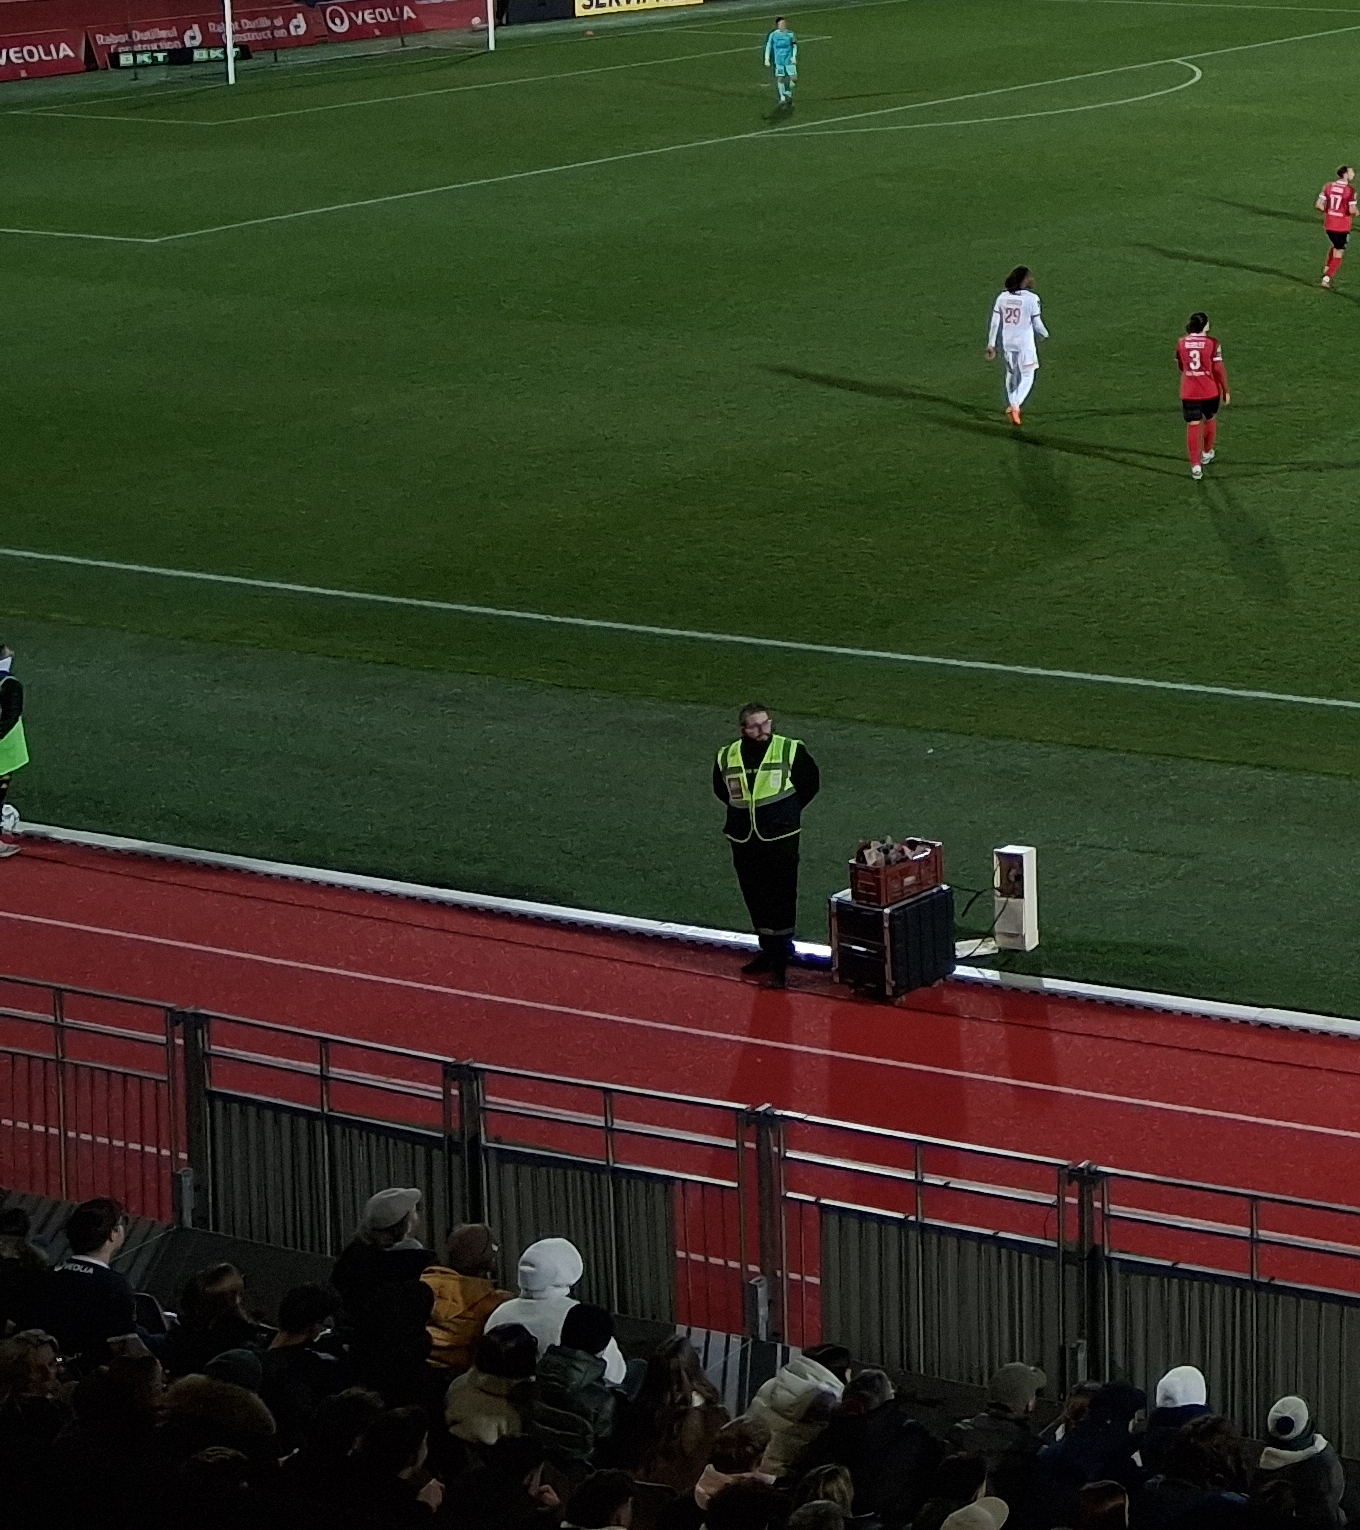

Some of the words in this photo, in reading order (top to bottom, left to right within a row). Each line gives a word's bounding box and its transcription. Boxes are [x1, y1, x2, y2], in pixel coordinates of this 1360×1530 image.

[350, 5, 417, 25] VEOLIA
[1004, 307, 1021, 326] 29
[1189, 349, 1201, 370] 3
